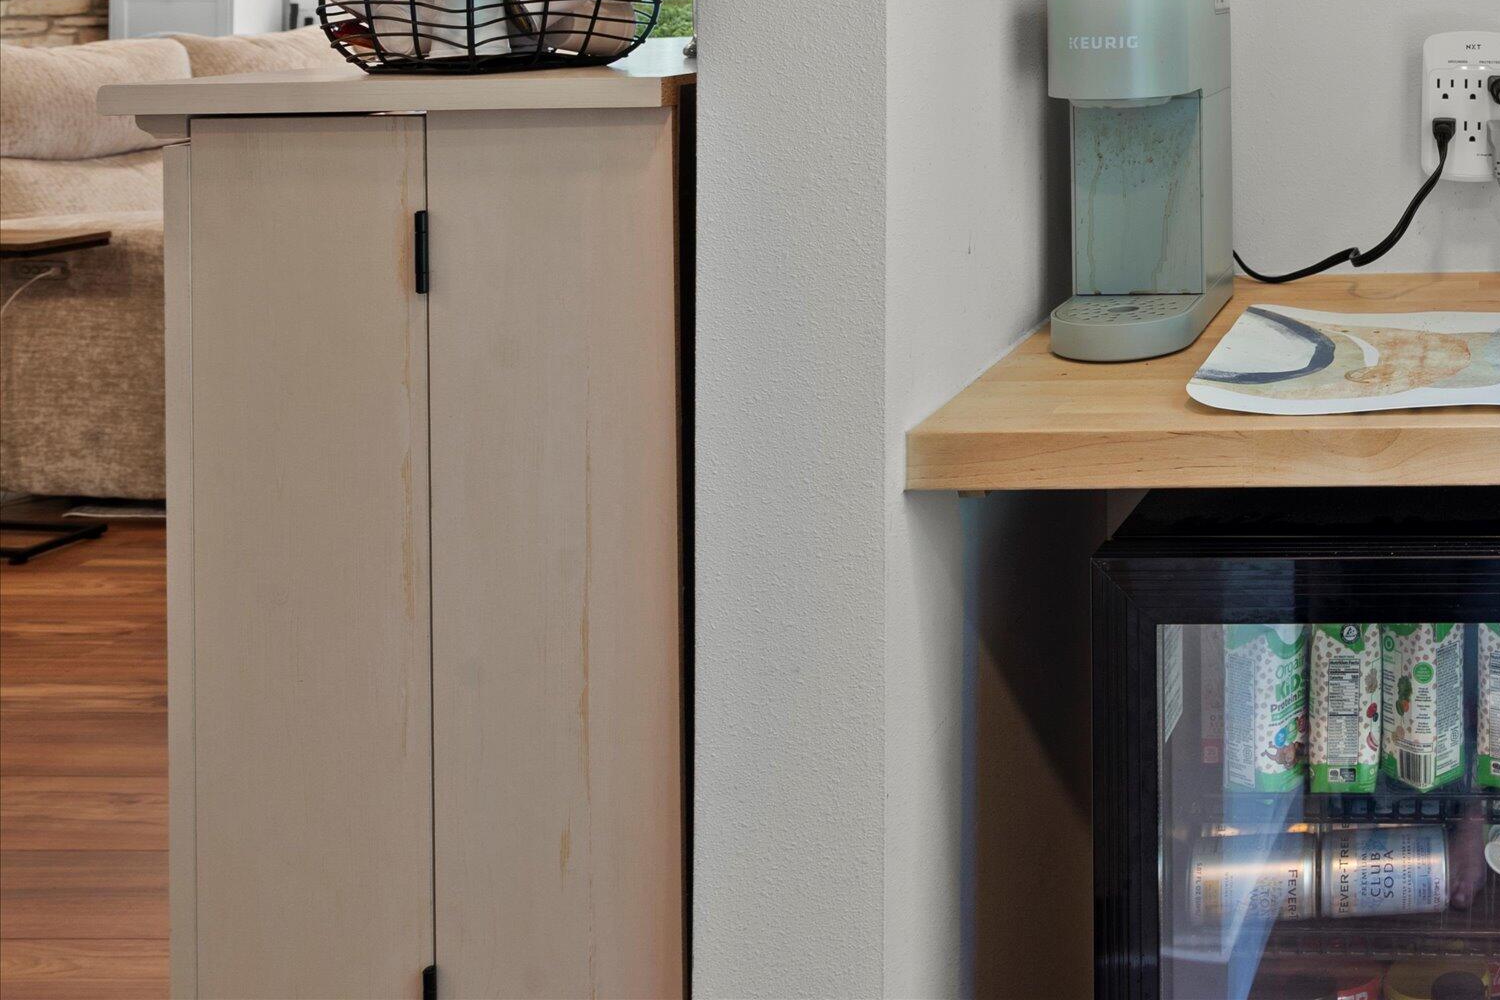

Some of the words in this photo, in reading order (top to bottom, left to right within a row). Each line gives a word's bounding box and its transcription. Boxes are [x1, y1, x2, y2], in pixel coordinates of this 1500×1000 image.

[1068, 35, 1139, 50] KEURIG
[1371, 852, 1381, 898] CLUB
[1384, 849, 1395, 898] SODA
